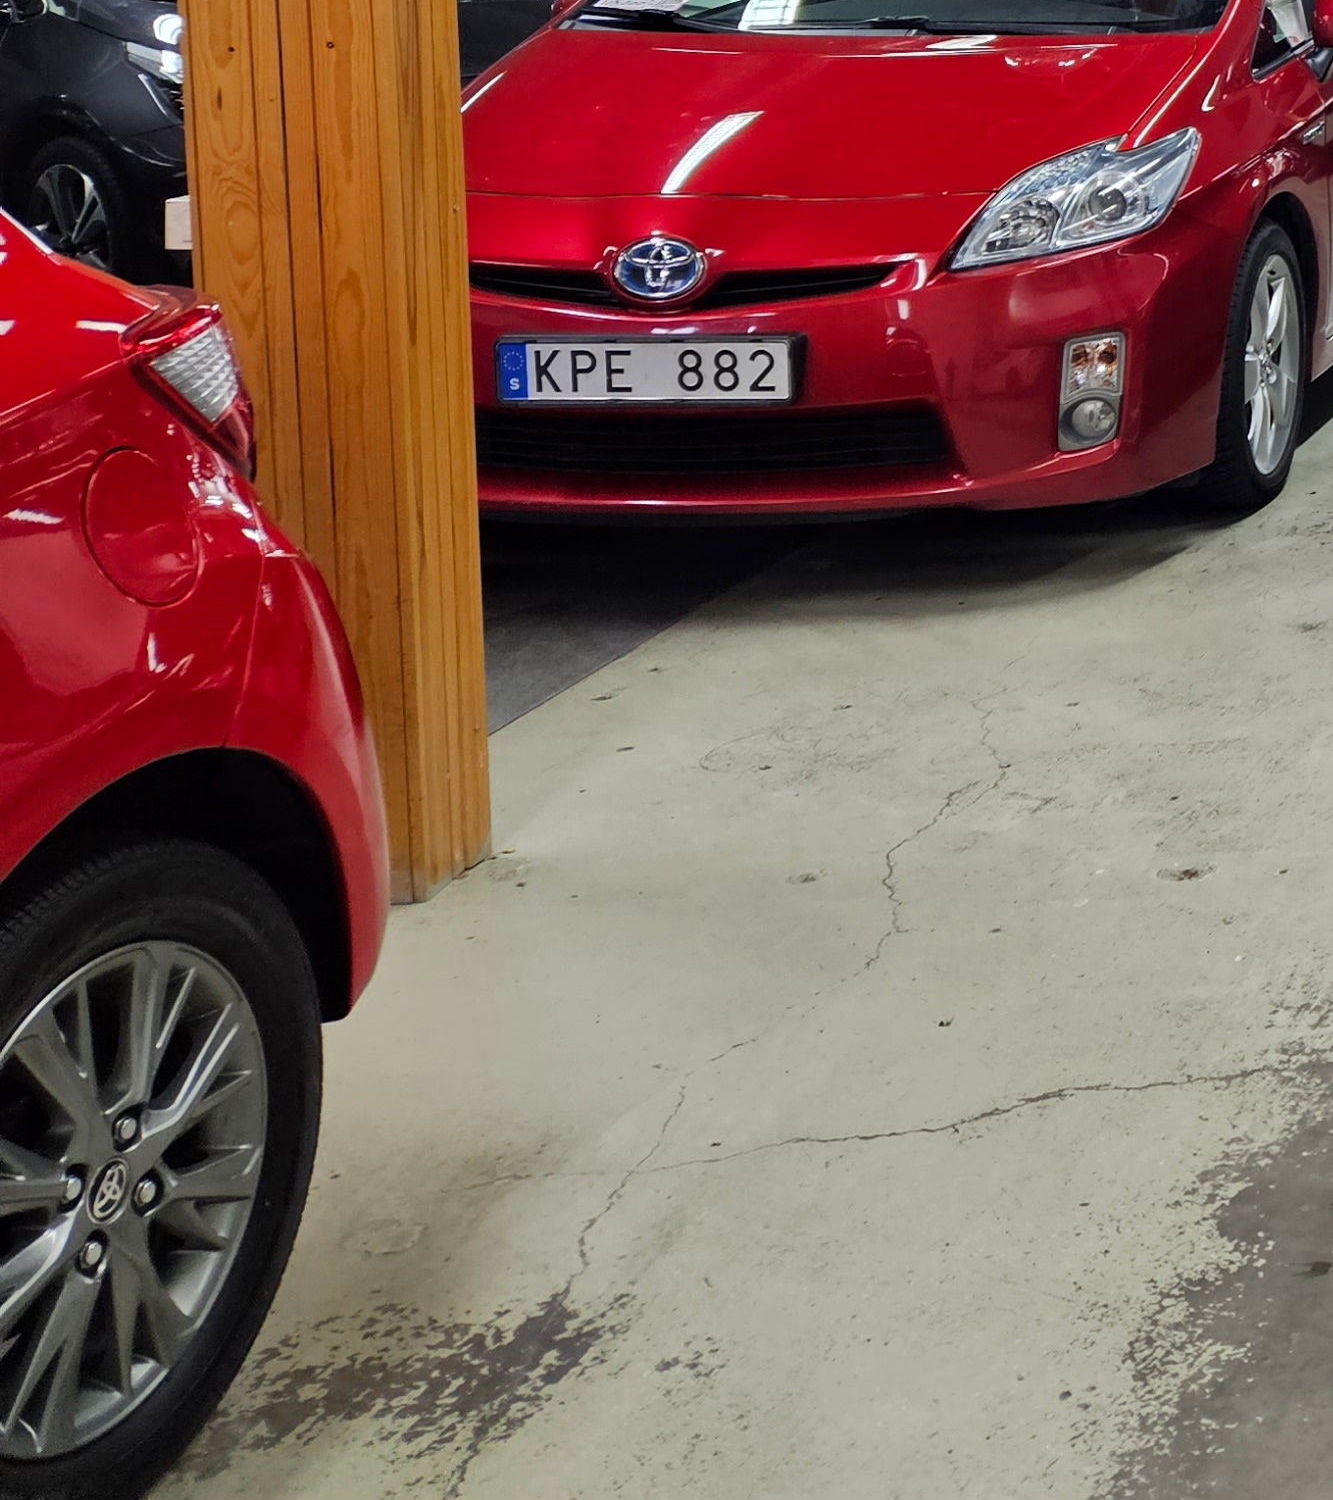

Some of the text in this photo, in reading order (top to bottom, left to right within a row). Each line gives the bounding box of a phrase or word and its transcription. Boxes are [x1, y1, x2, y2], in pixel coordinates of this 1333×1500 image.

[509, 349, 776, 393] S KPE 882
